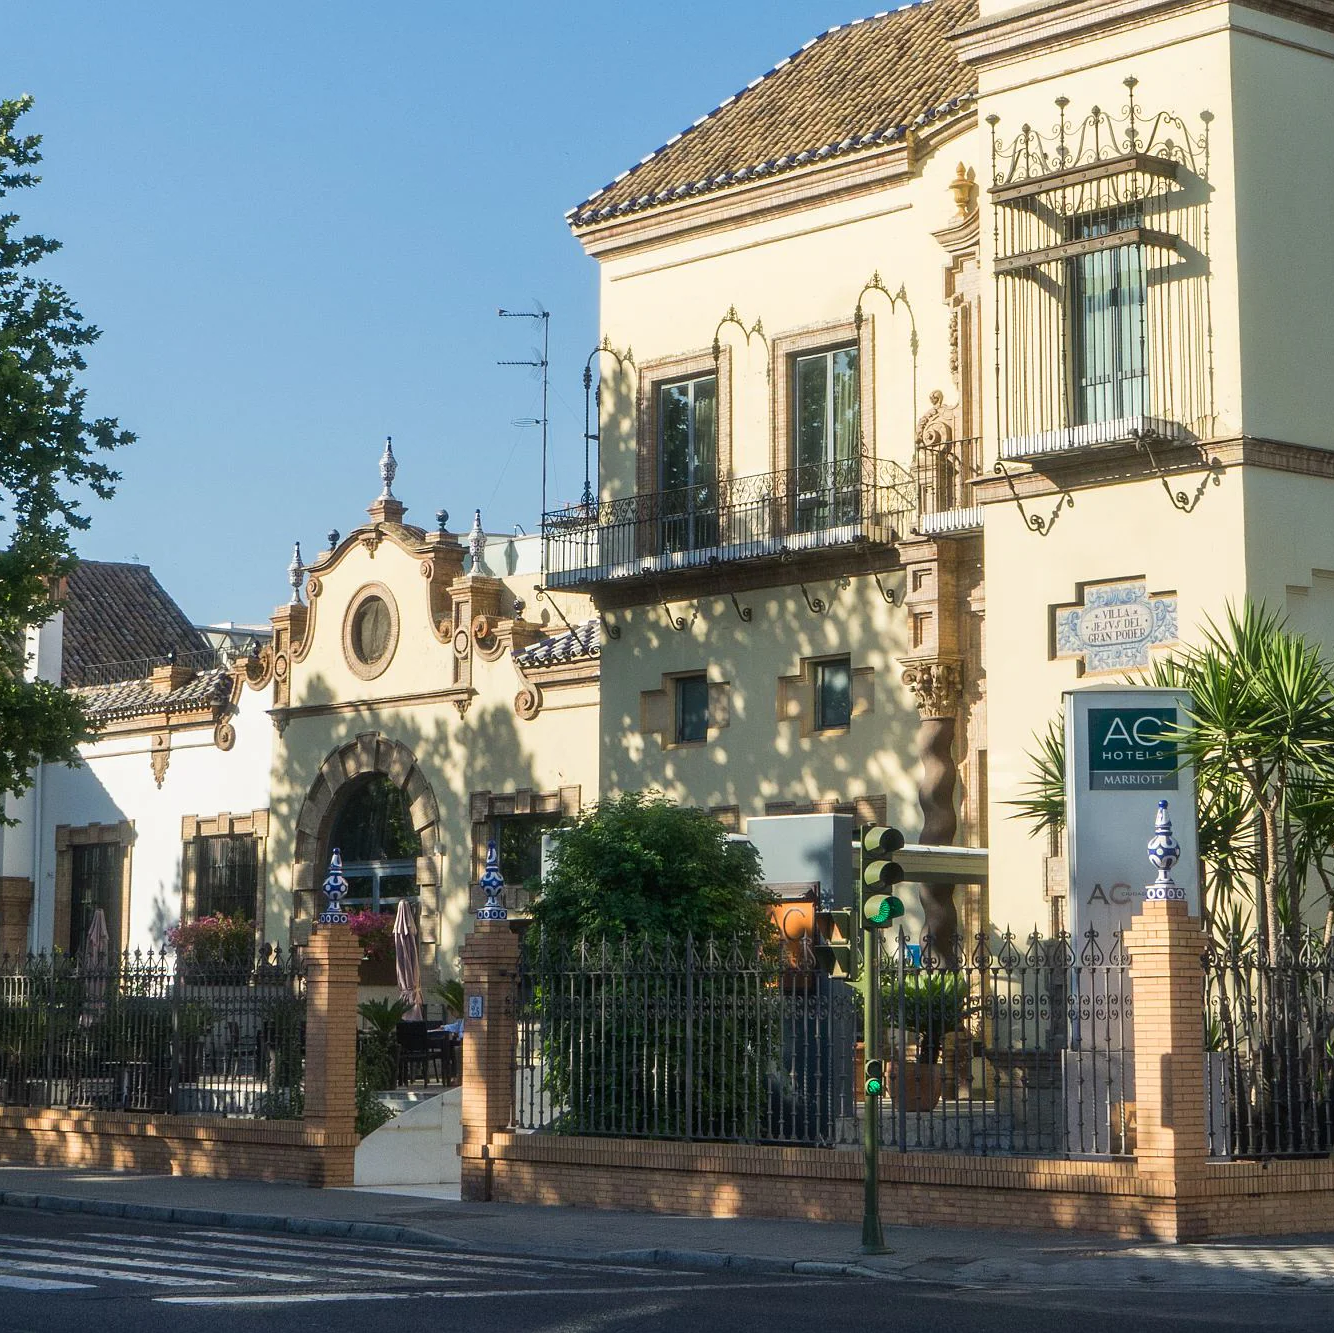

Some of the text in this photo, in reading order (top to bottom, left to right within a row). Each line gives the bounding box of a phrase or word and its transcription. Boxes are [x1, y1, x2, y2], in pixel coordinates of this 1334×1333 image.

[1102, 607, 1130, 619] VILLA
[1124, 617, 1142, 628] DEL
[1088, 628, 1146, 644] GRAN PODER
[1103, 716, 1162, 746] AC
[1102, 751, 1164, 760] HOTELS
[1104, 775, 1165, 785] MARRIOTT
[1087, 883, 1132, 905] AC
